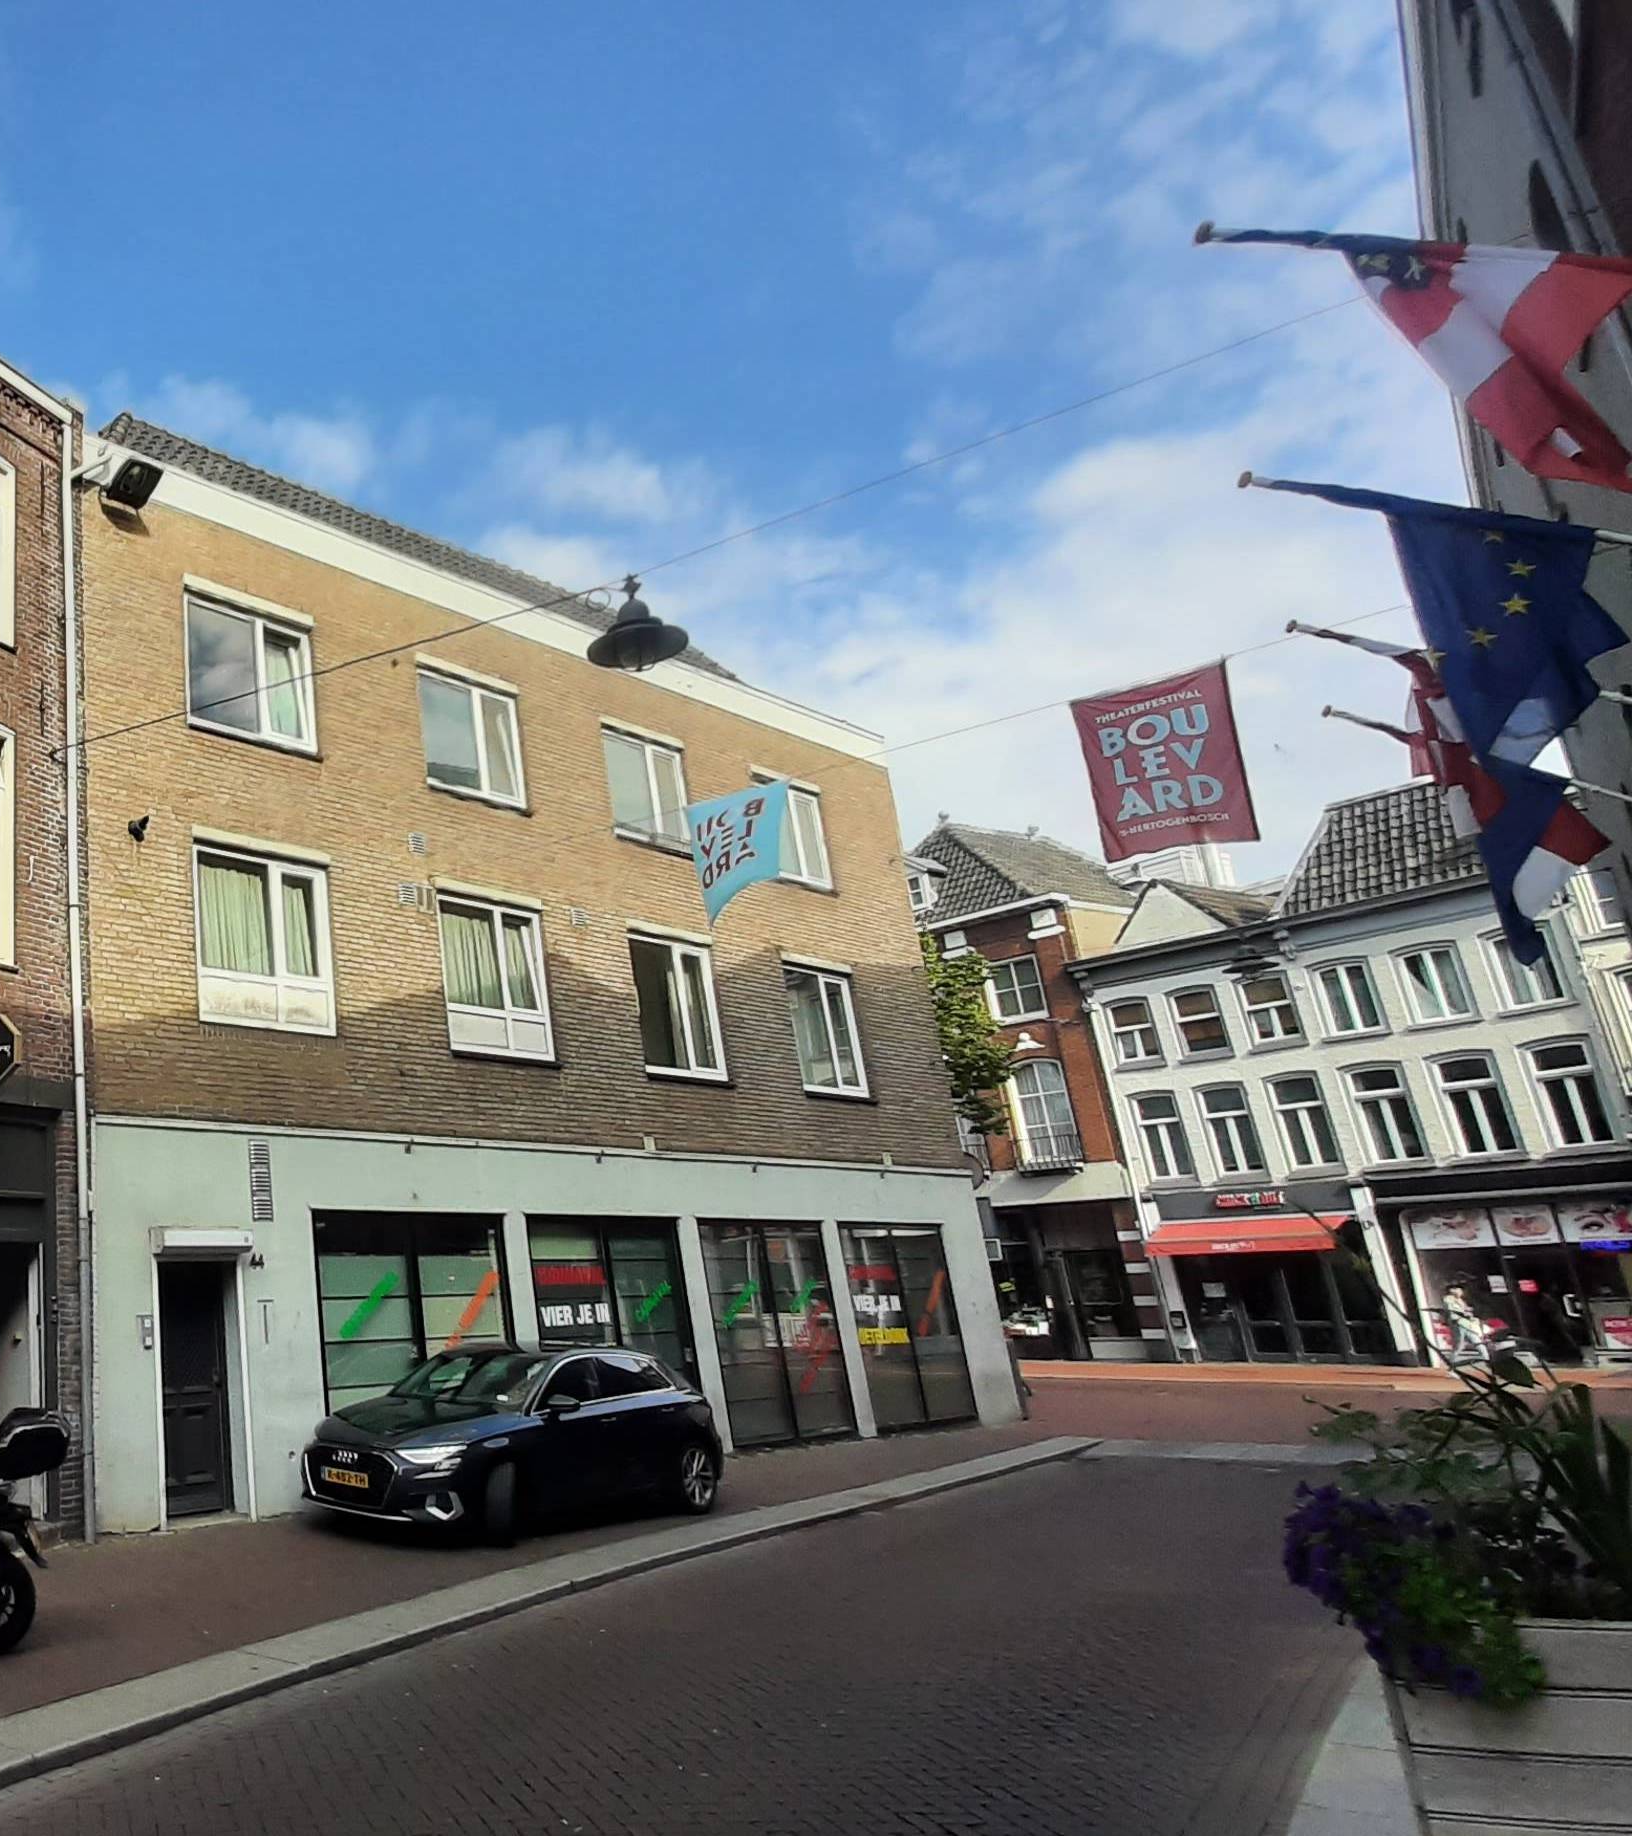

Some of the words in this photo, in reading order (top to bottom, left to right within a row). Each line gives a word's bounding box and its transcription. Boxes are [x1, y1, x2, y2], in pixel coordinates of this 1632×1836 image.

[1095, 689, 1202, 724] THEATERFESTIVAL
[1098, 703, 1209, 757] BOU
[1113, 738, 1205, 785] LEV
[1117, 774, 1223, 822] ARD
[540, 1305, 574, 1327] VIER
[576, 1304, 595, 1325] JE
[595, 1303, 611, 1323] IN
